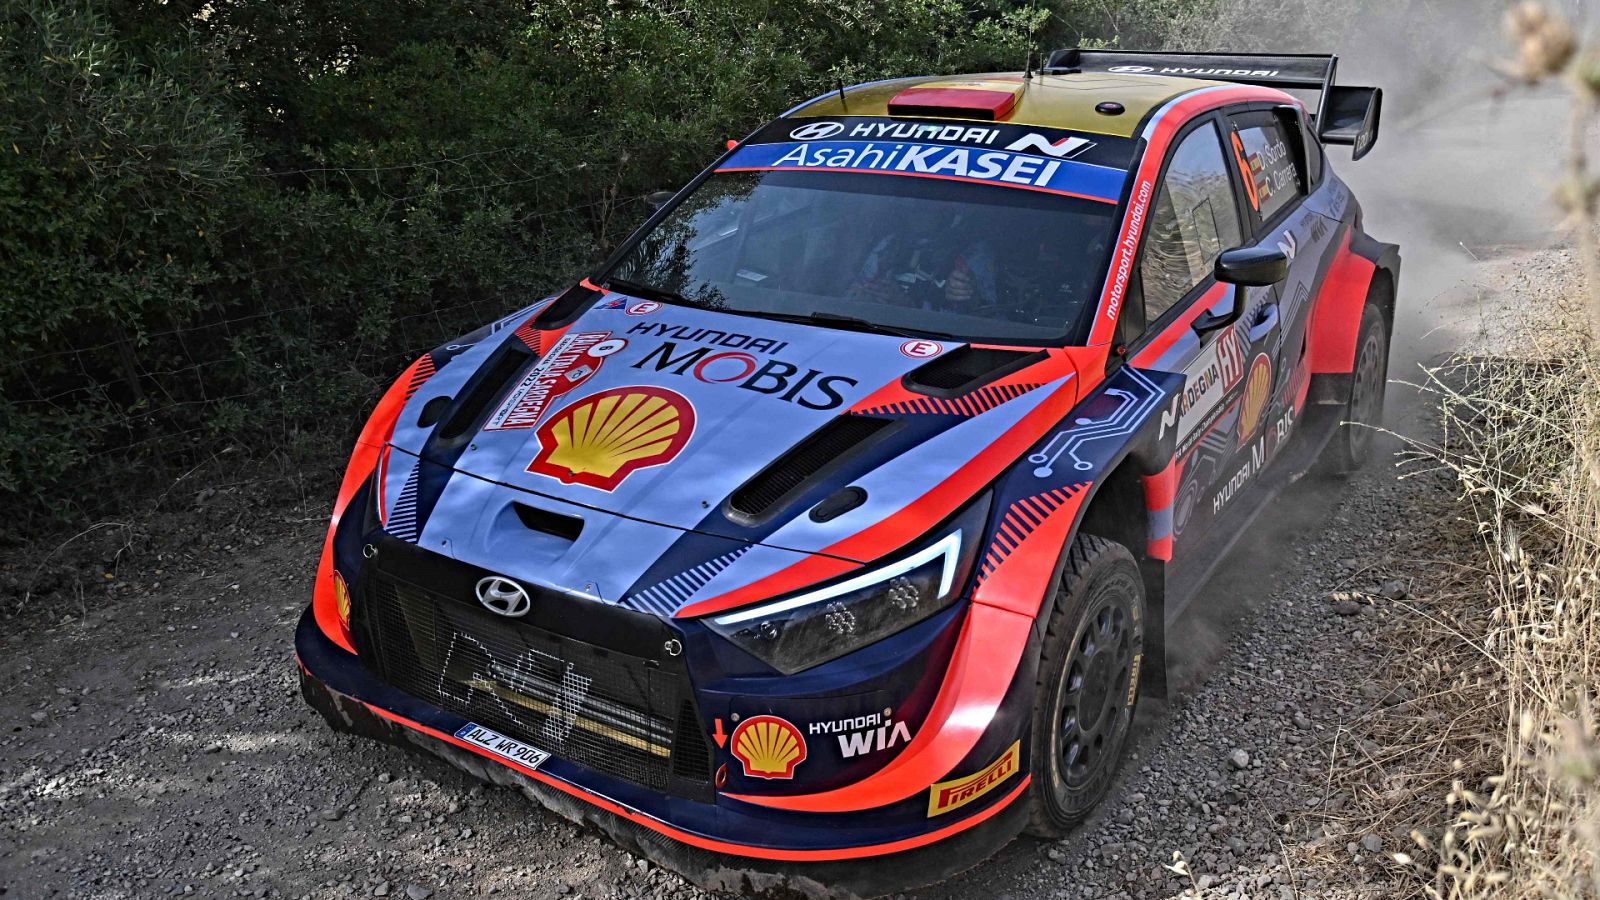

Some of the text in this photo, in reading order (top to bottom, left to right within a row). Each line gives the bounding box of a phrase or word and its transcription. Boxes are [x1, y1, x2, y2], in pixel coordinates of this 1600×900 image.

[1159, 66, 1279, 78] HYUNDAI
[849, 122, 1000, 145] HYUNDAI
[1264, 140, 1286, 164] Sordo
[1231, 131, 1258, 211] 6
[1106, 180, 1151, 320] motorsport.hyundai.com
[635, 302, 653, 314] E
[626, 321, 790, 354] HYUNDAI
[910, 342, 934, 355] E
[520, 367, 545, 387] 2022
[632, 341, 859, 411] MOBIS
[1179, 364, 1220, 417] ARDEGNA
[503, 379, 557, 426] SARDEGNA
[1213, 461, 1250, 515] HYUNDAI
[809, 713, 881, 735] HYUNDAI
[837, 718, 912, 758] WIA
[467, 728, 543, 764] ALZ WR 906
[937, 750, 1013, 809] PIRELLI
